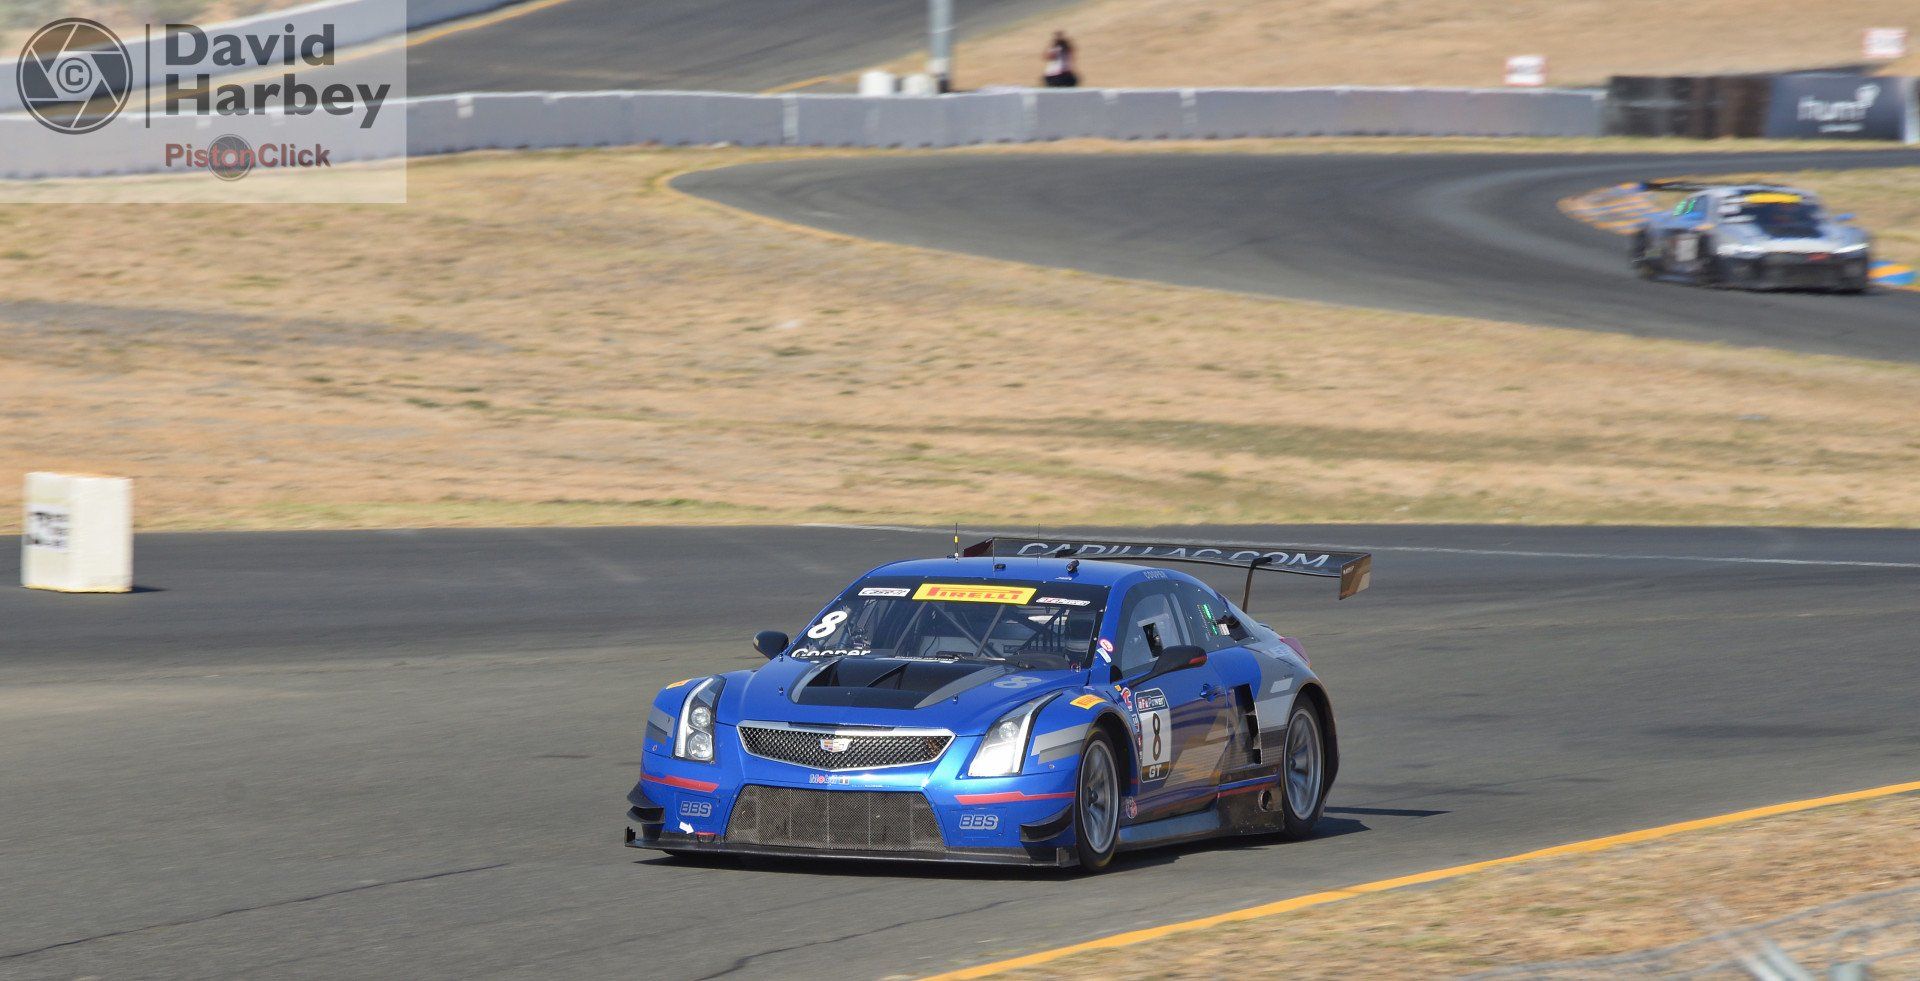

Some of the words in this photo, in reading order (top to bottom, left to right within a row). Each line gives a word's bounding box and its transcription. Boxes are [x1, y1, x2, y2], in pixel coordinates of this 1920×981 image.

[1017, 542, 1329, 568] CADILLACCOM
[927, 586, 1024, 601] PIRELLI
[807, 610, 848, 639] 8
[1152, 712, 1162, 761] 8
[1149, 764, 1162, 778] GT
[680, 801, 712, 817] BBS
[959, 814, 999, 830] BBS
